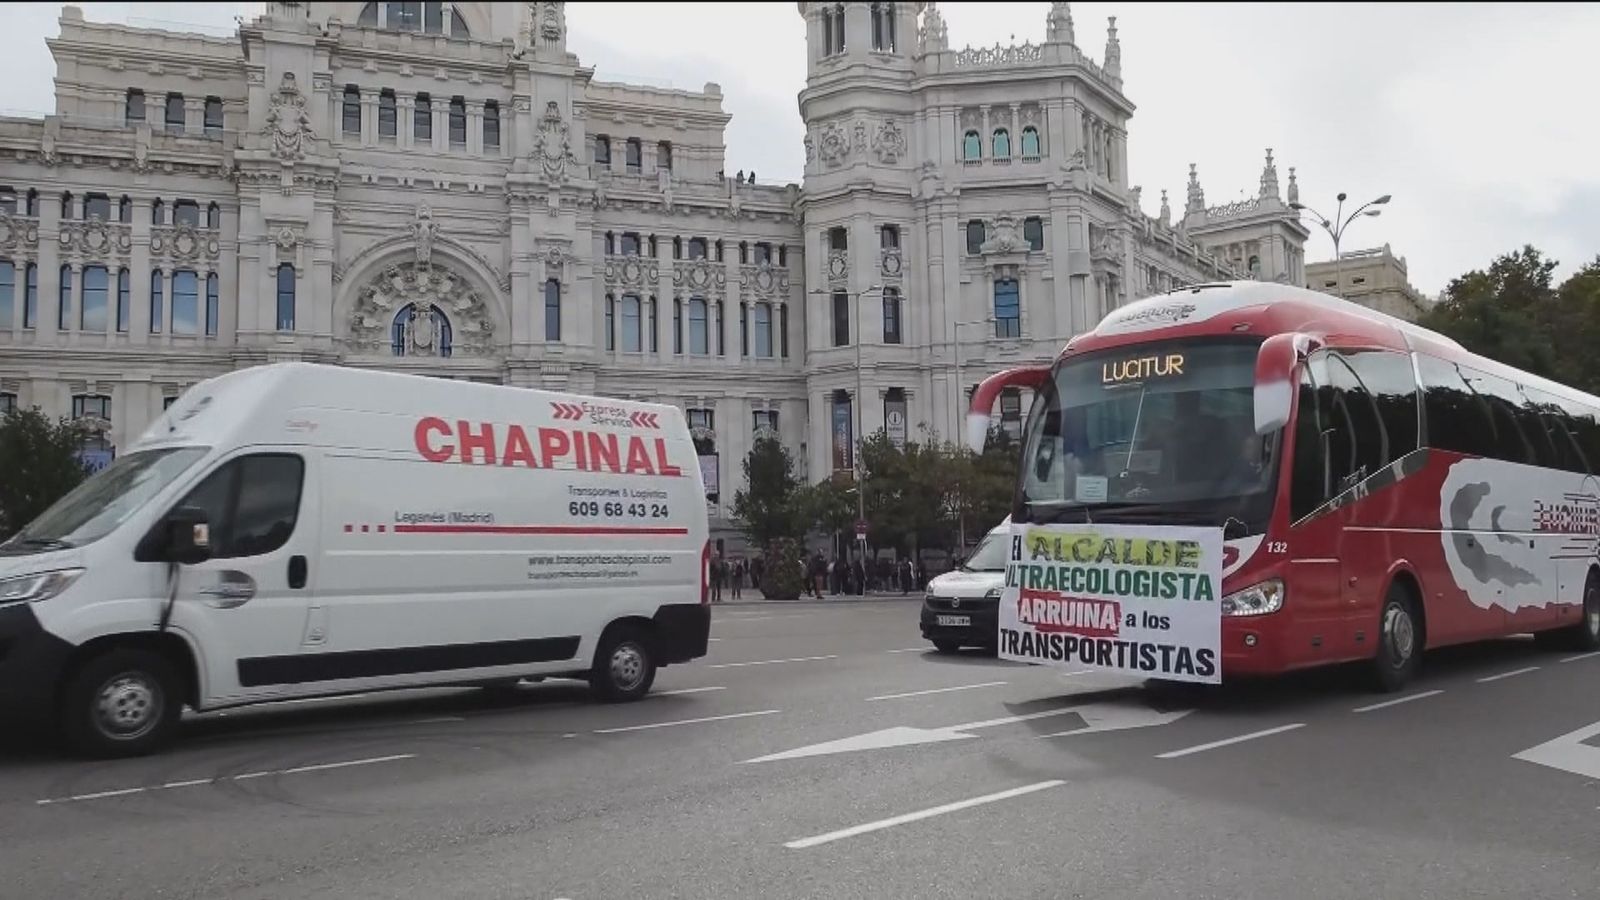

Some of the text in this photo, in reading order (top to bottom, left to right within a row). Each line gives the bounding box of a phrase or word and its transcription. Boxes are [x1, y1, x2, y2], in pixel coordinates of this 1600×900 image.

[1102, 354, 1184, 383] LUCITUR
[582, 402, 627, 417] Express
[591, 414, 633, 428] Service
[414, 416, 681, 477] CHAPINAL
[395, 510, 445, 525] Leganés
[569, 501, 668, 518] 609 68 43 24
[1031, 535, 1200, 568] ALCALDE
[1267, 541, 1288, 553] 132
[1005, 564, 1214, 601] ULTRAECOLOGISTA
[1020, 597, 1171, 631] ARRUINA a los
[1000, 628, 1216, 677] TRANSPORTISTAS
